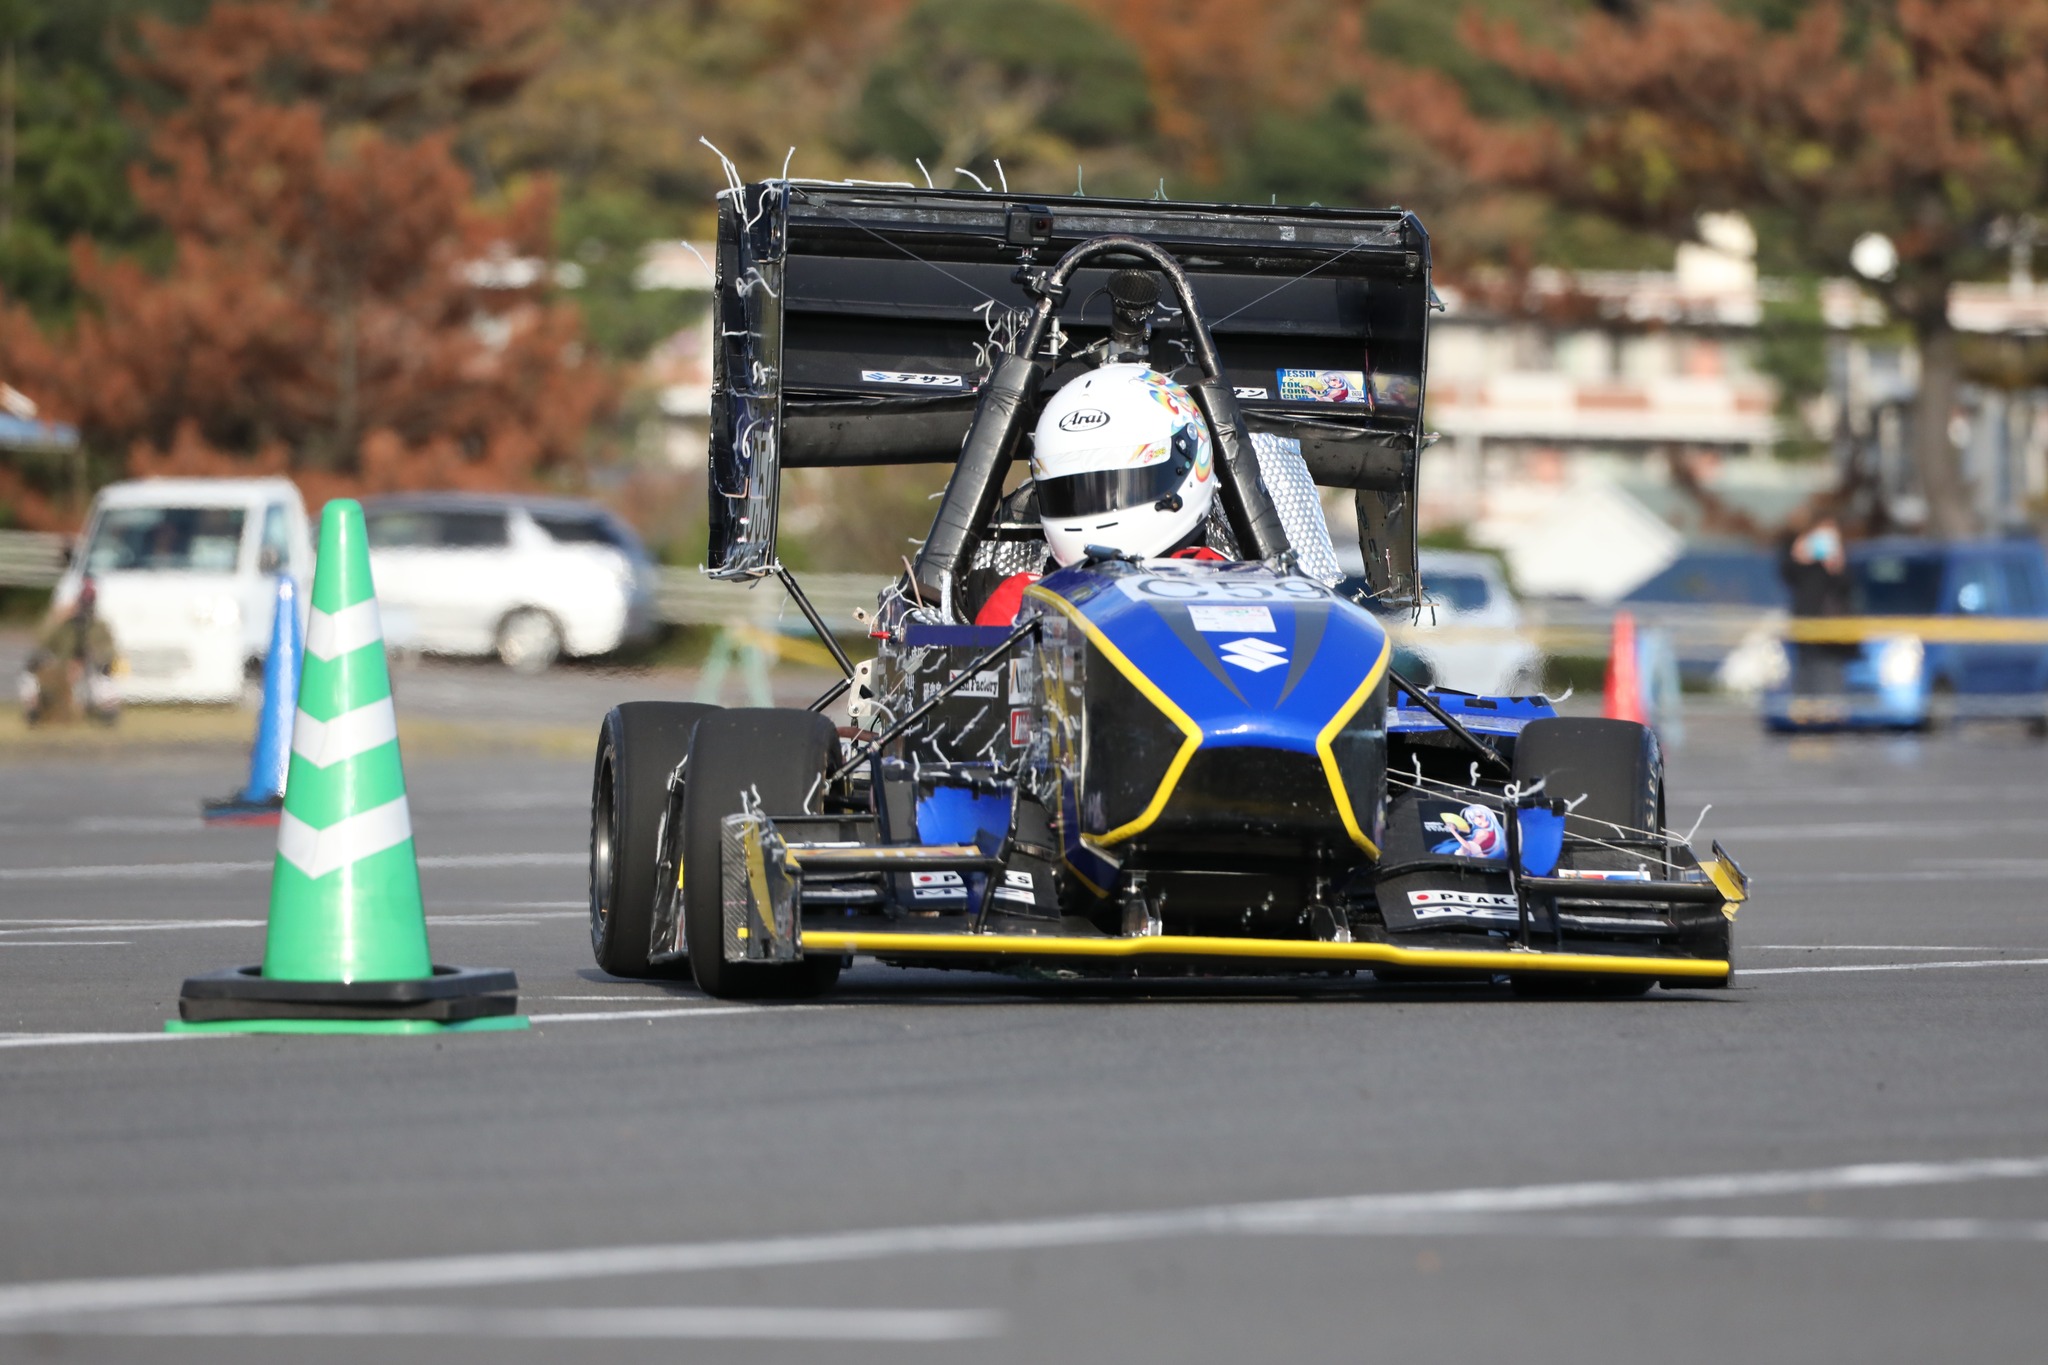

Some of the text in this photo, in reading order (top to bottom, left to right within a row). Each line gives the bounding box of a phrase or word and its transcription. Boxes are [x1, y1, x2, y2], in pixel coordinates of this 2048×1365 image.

[897, 374, 959, 385] デサン
[1061, 411, 1103, 428] Arai
[1137, 578, 1332, 600] C59
